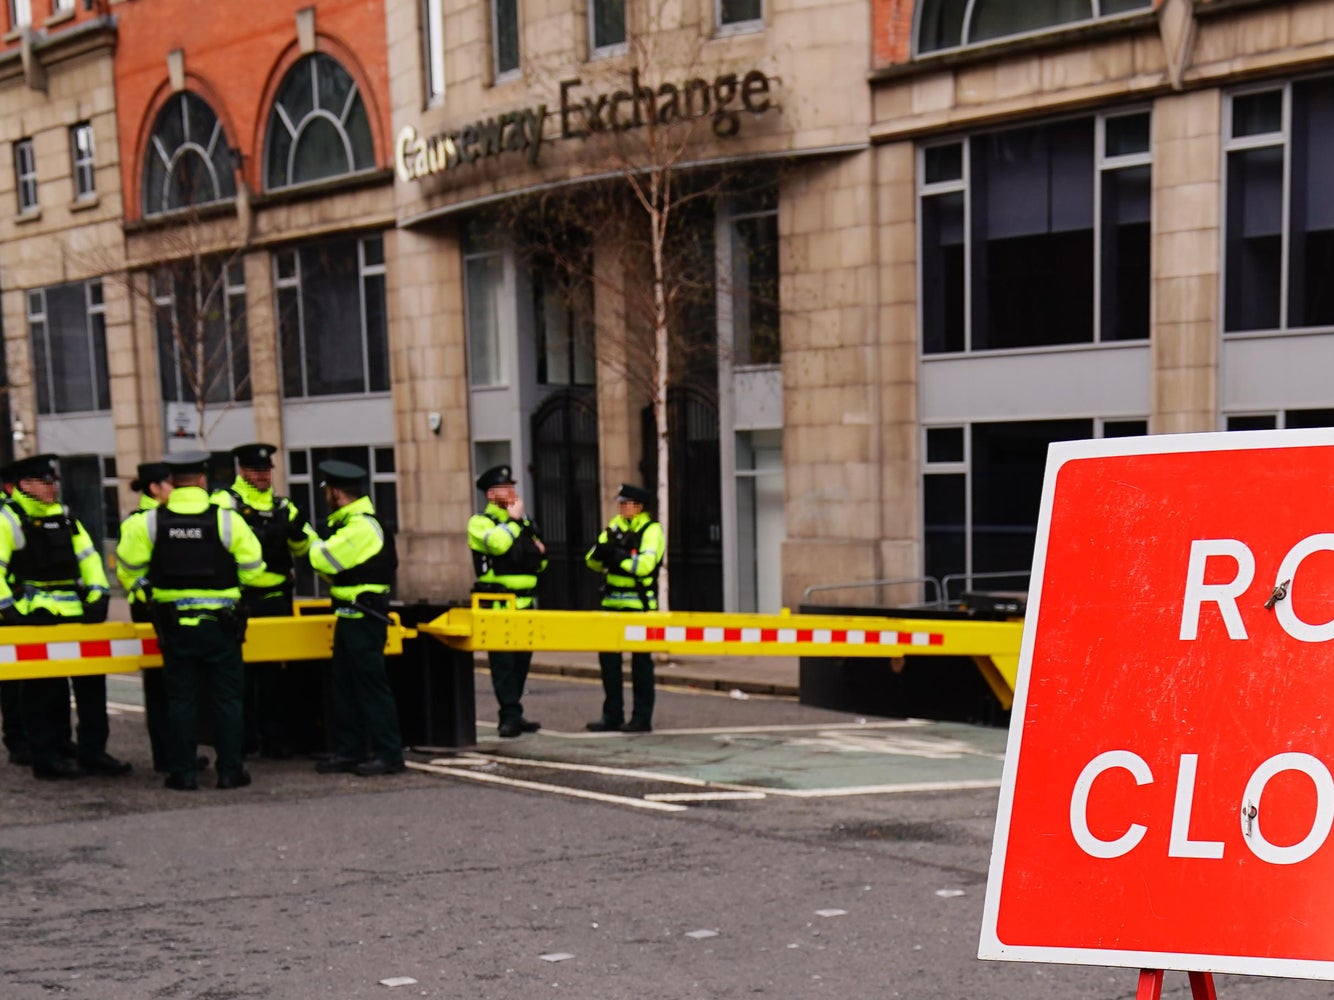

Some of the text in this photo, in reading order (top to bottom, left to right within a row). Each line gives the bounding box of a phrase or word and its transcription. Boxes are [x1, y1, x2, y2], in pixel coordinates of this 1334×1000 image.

[395, 66, 770, 182] Causeway Exchange
[169, 528, 202, 538] POLICE
